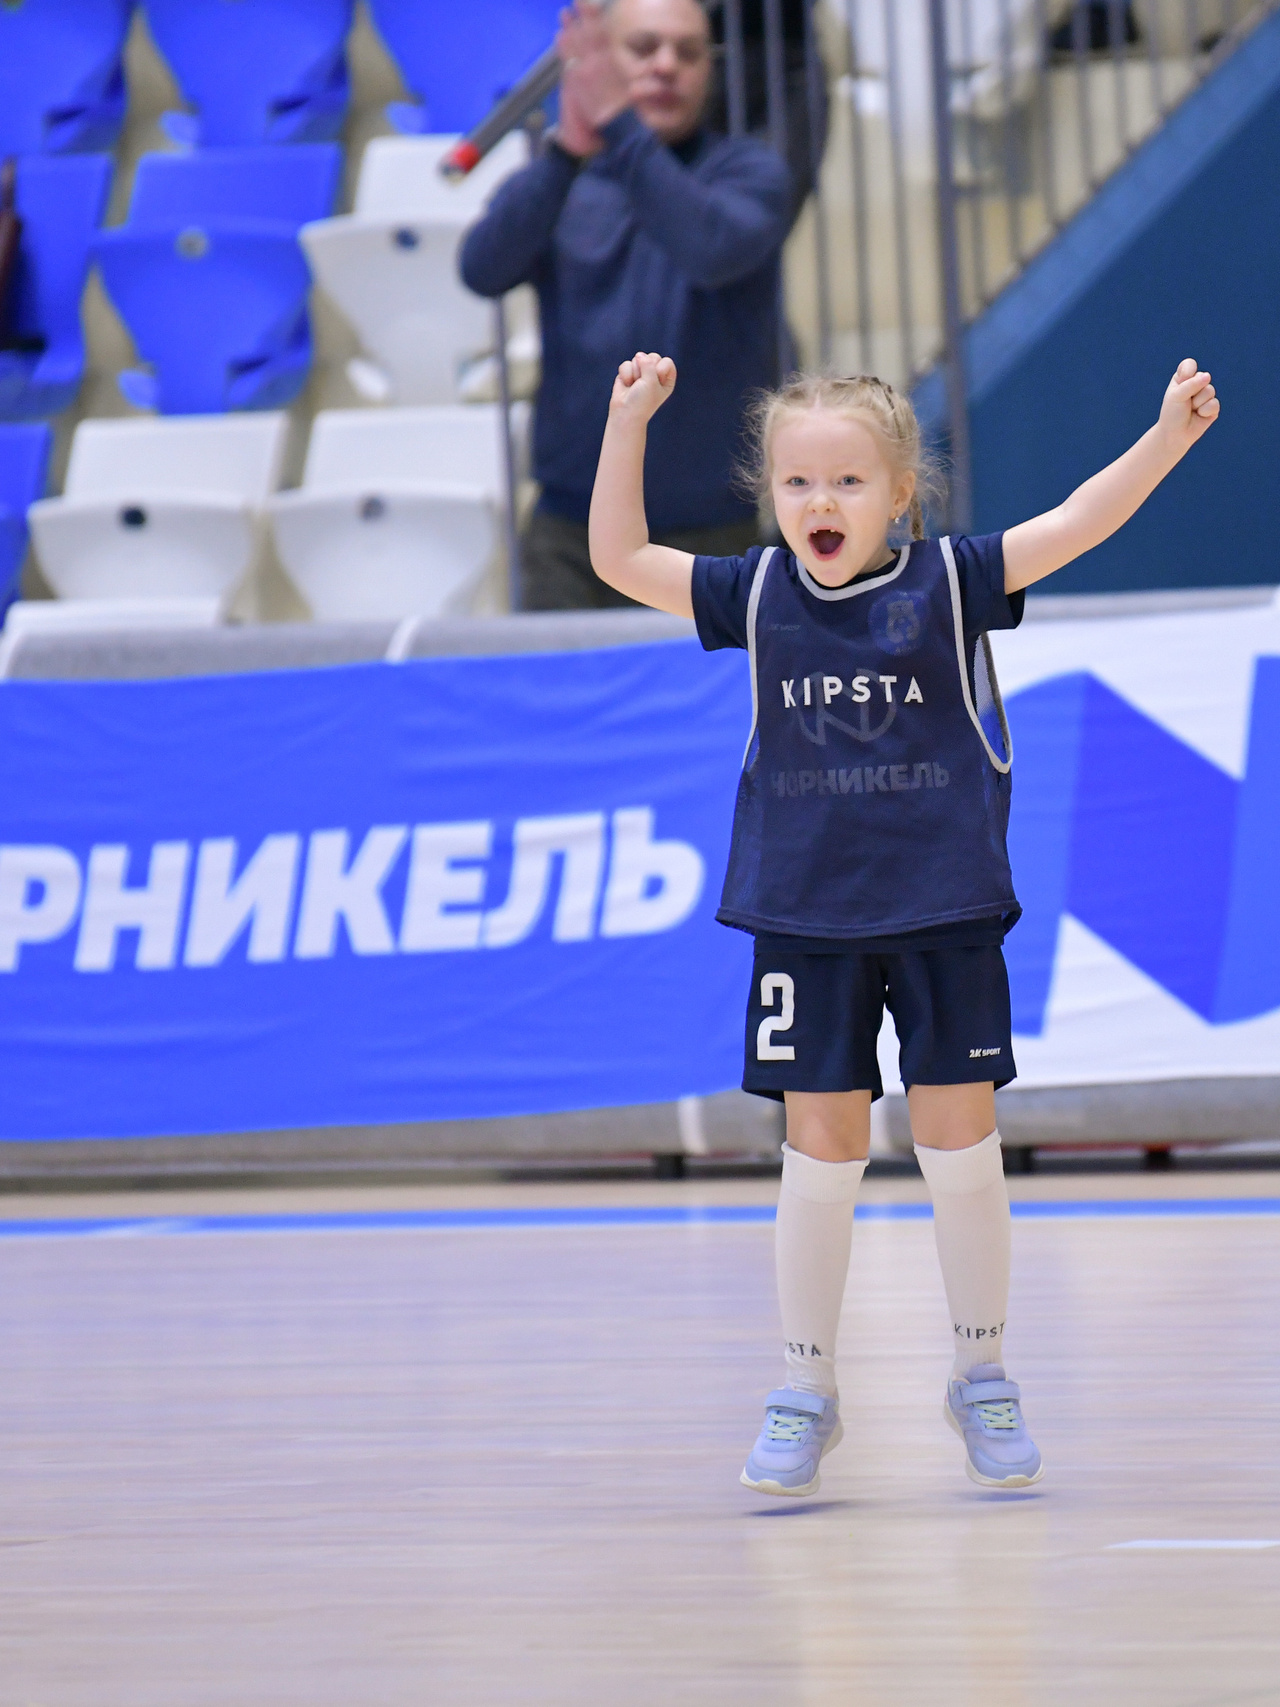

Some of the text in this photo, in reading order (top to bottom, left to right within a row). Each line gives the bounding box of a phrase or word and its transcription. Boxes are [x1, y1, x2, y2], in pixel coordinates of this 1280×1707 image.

[781, 675, 924, 708] KIPSTA
[756, 972, 796, 1061] 2
[982, 1047, 1001, 1057] SPORT
